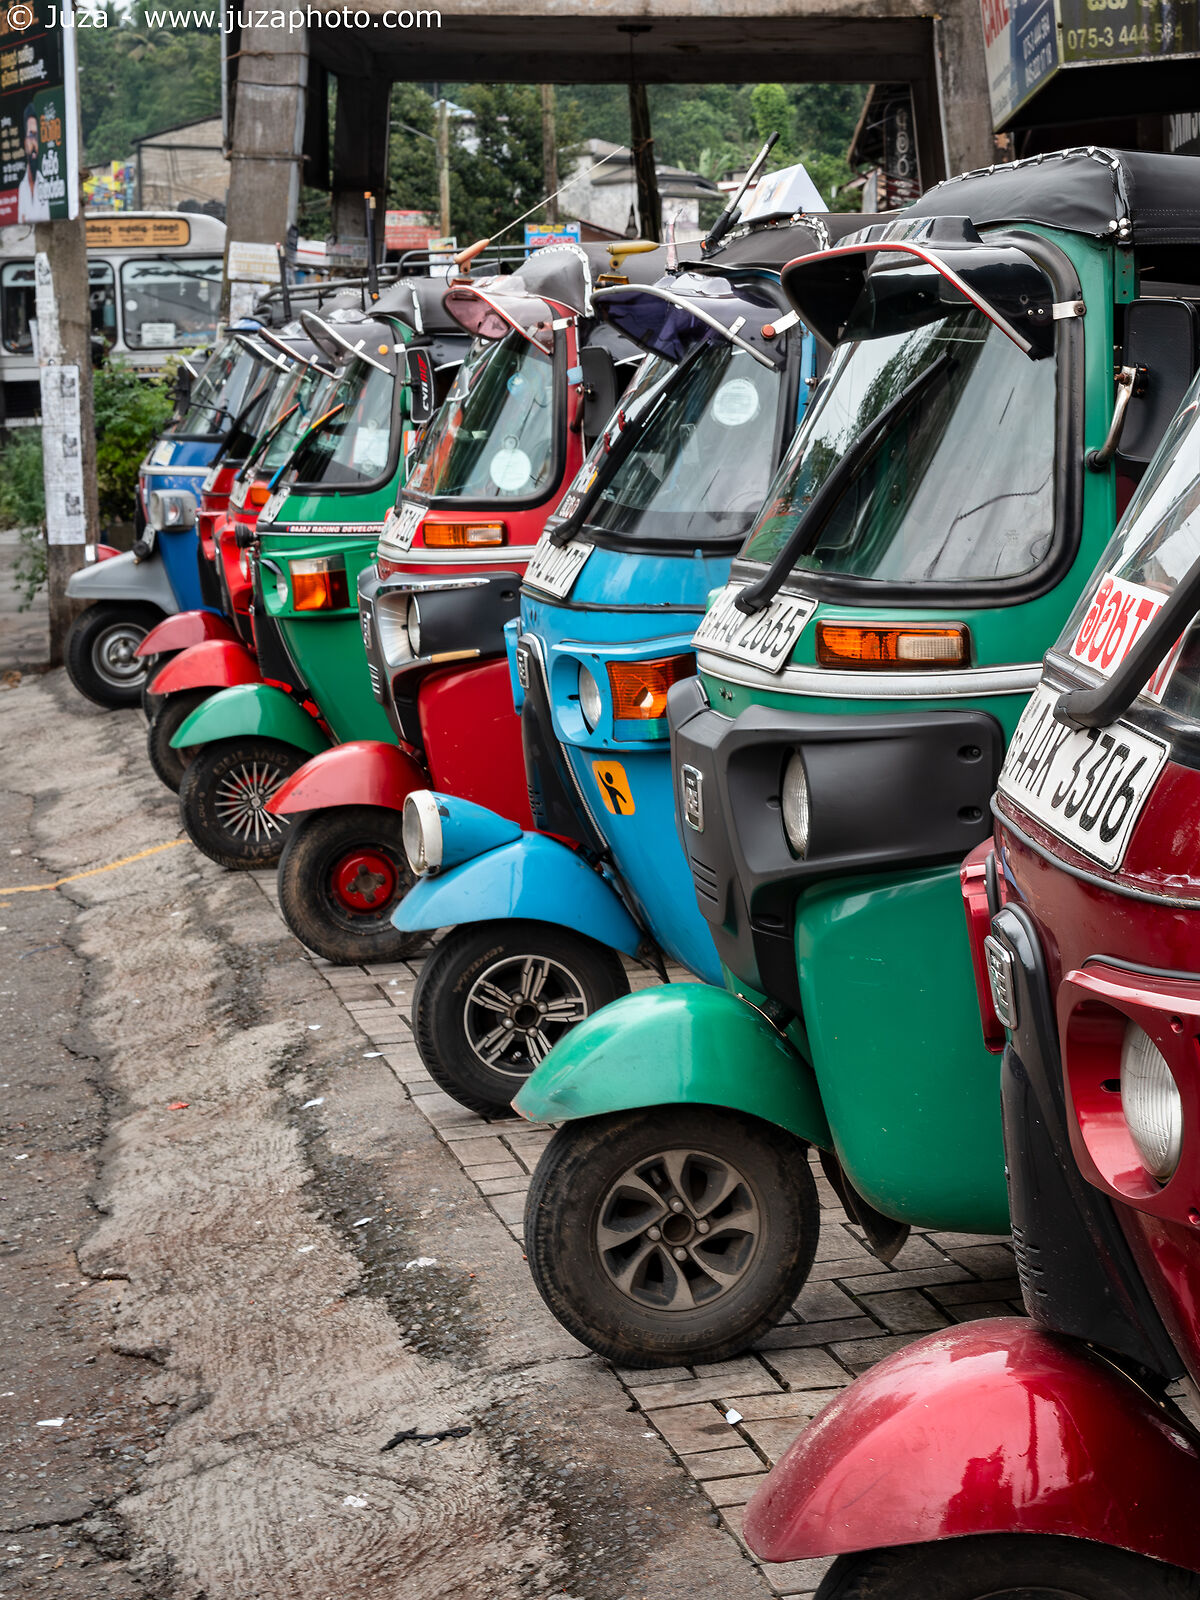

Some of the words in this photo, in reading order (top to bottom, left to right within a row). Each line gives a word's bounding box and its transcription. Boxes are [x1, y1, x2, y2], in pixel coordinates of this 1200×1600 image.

[1067, 26, 1114, 50] 075-3
[1118, 23, 1149, 46] 444
[289, 525, 311, 533] BAJAJ
[312, 525, 340, 533] RACING
[1009, 703, 1074, 798] AAK
[1050, 727, 1148, 843] 3306
